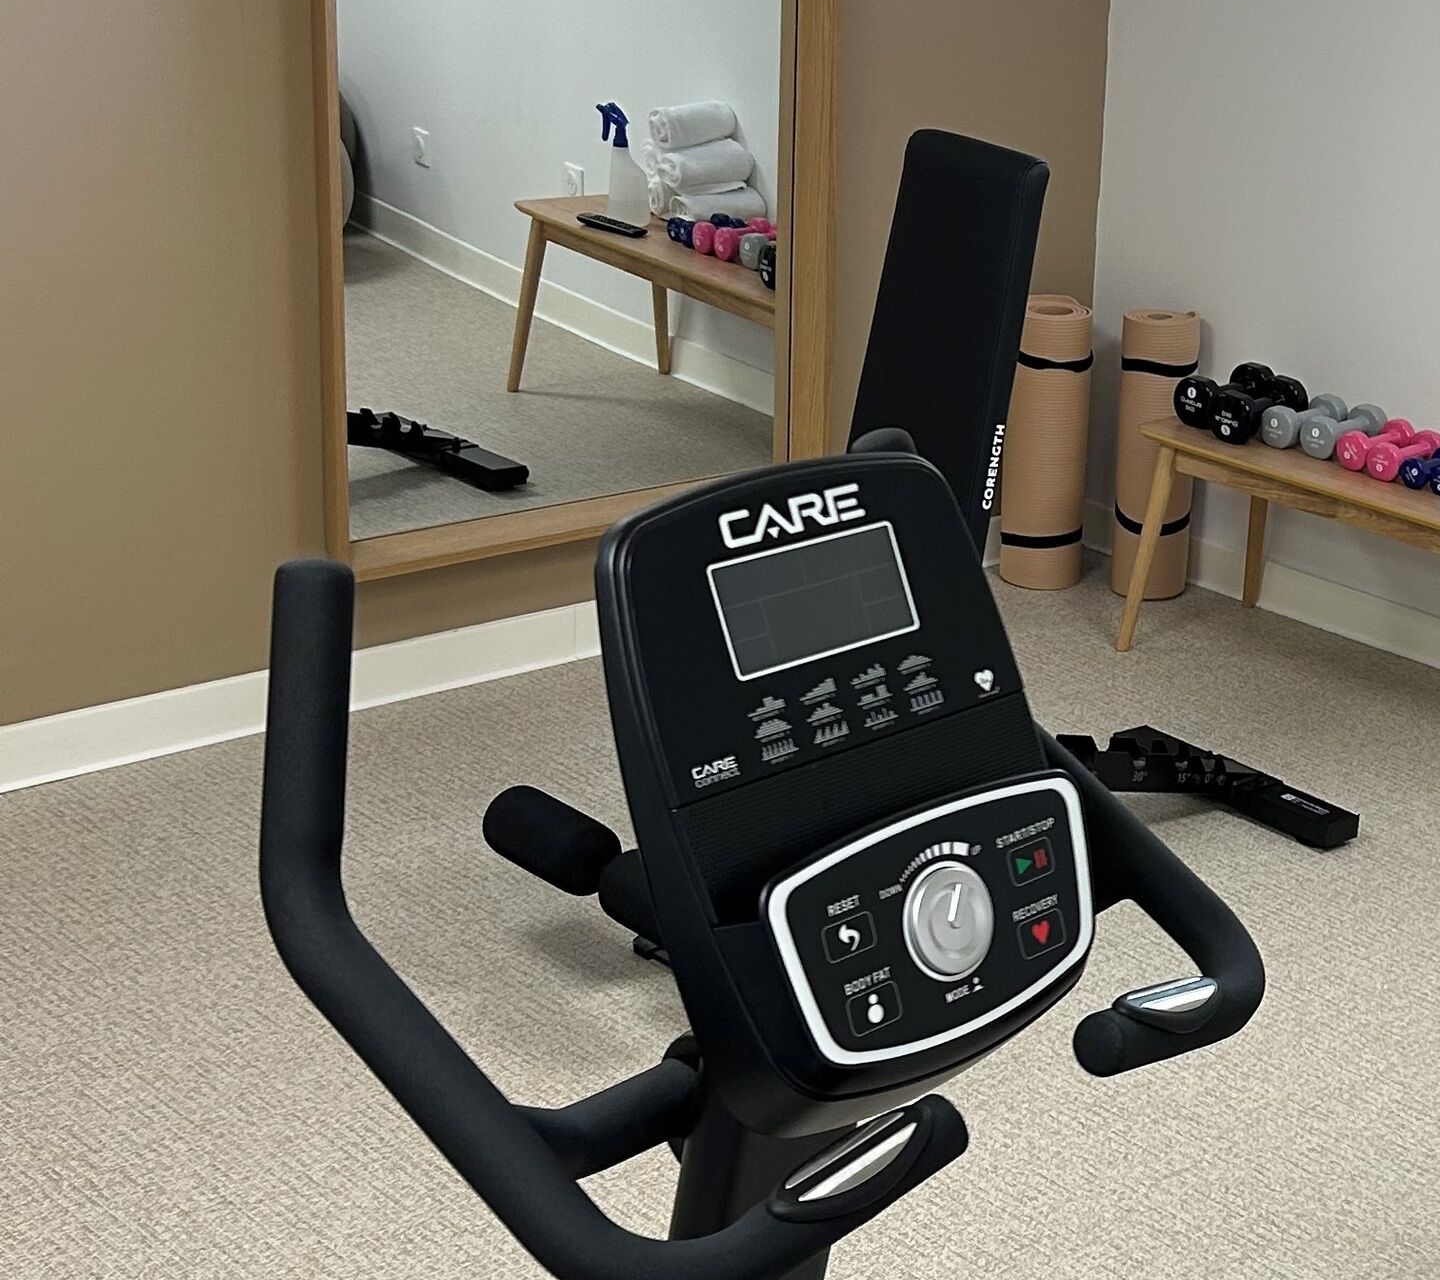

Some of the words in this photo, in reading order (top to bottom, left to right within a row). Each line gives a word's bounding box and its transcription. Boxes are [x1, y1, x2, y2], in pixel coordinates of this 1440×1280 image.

[982, 424, 1006, 510] CORENGTH
[718, 483, 867, 549] CARE
[691, 756, 739, 779] CARE
[826, 894, 861, 917] RESET
[1011, 894, 1059, 922] RECOVERY
[843, 974, 873, 996] BODY
[872, 966, 892, 984] FAT
